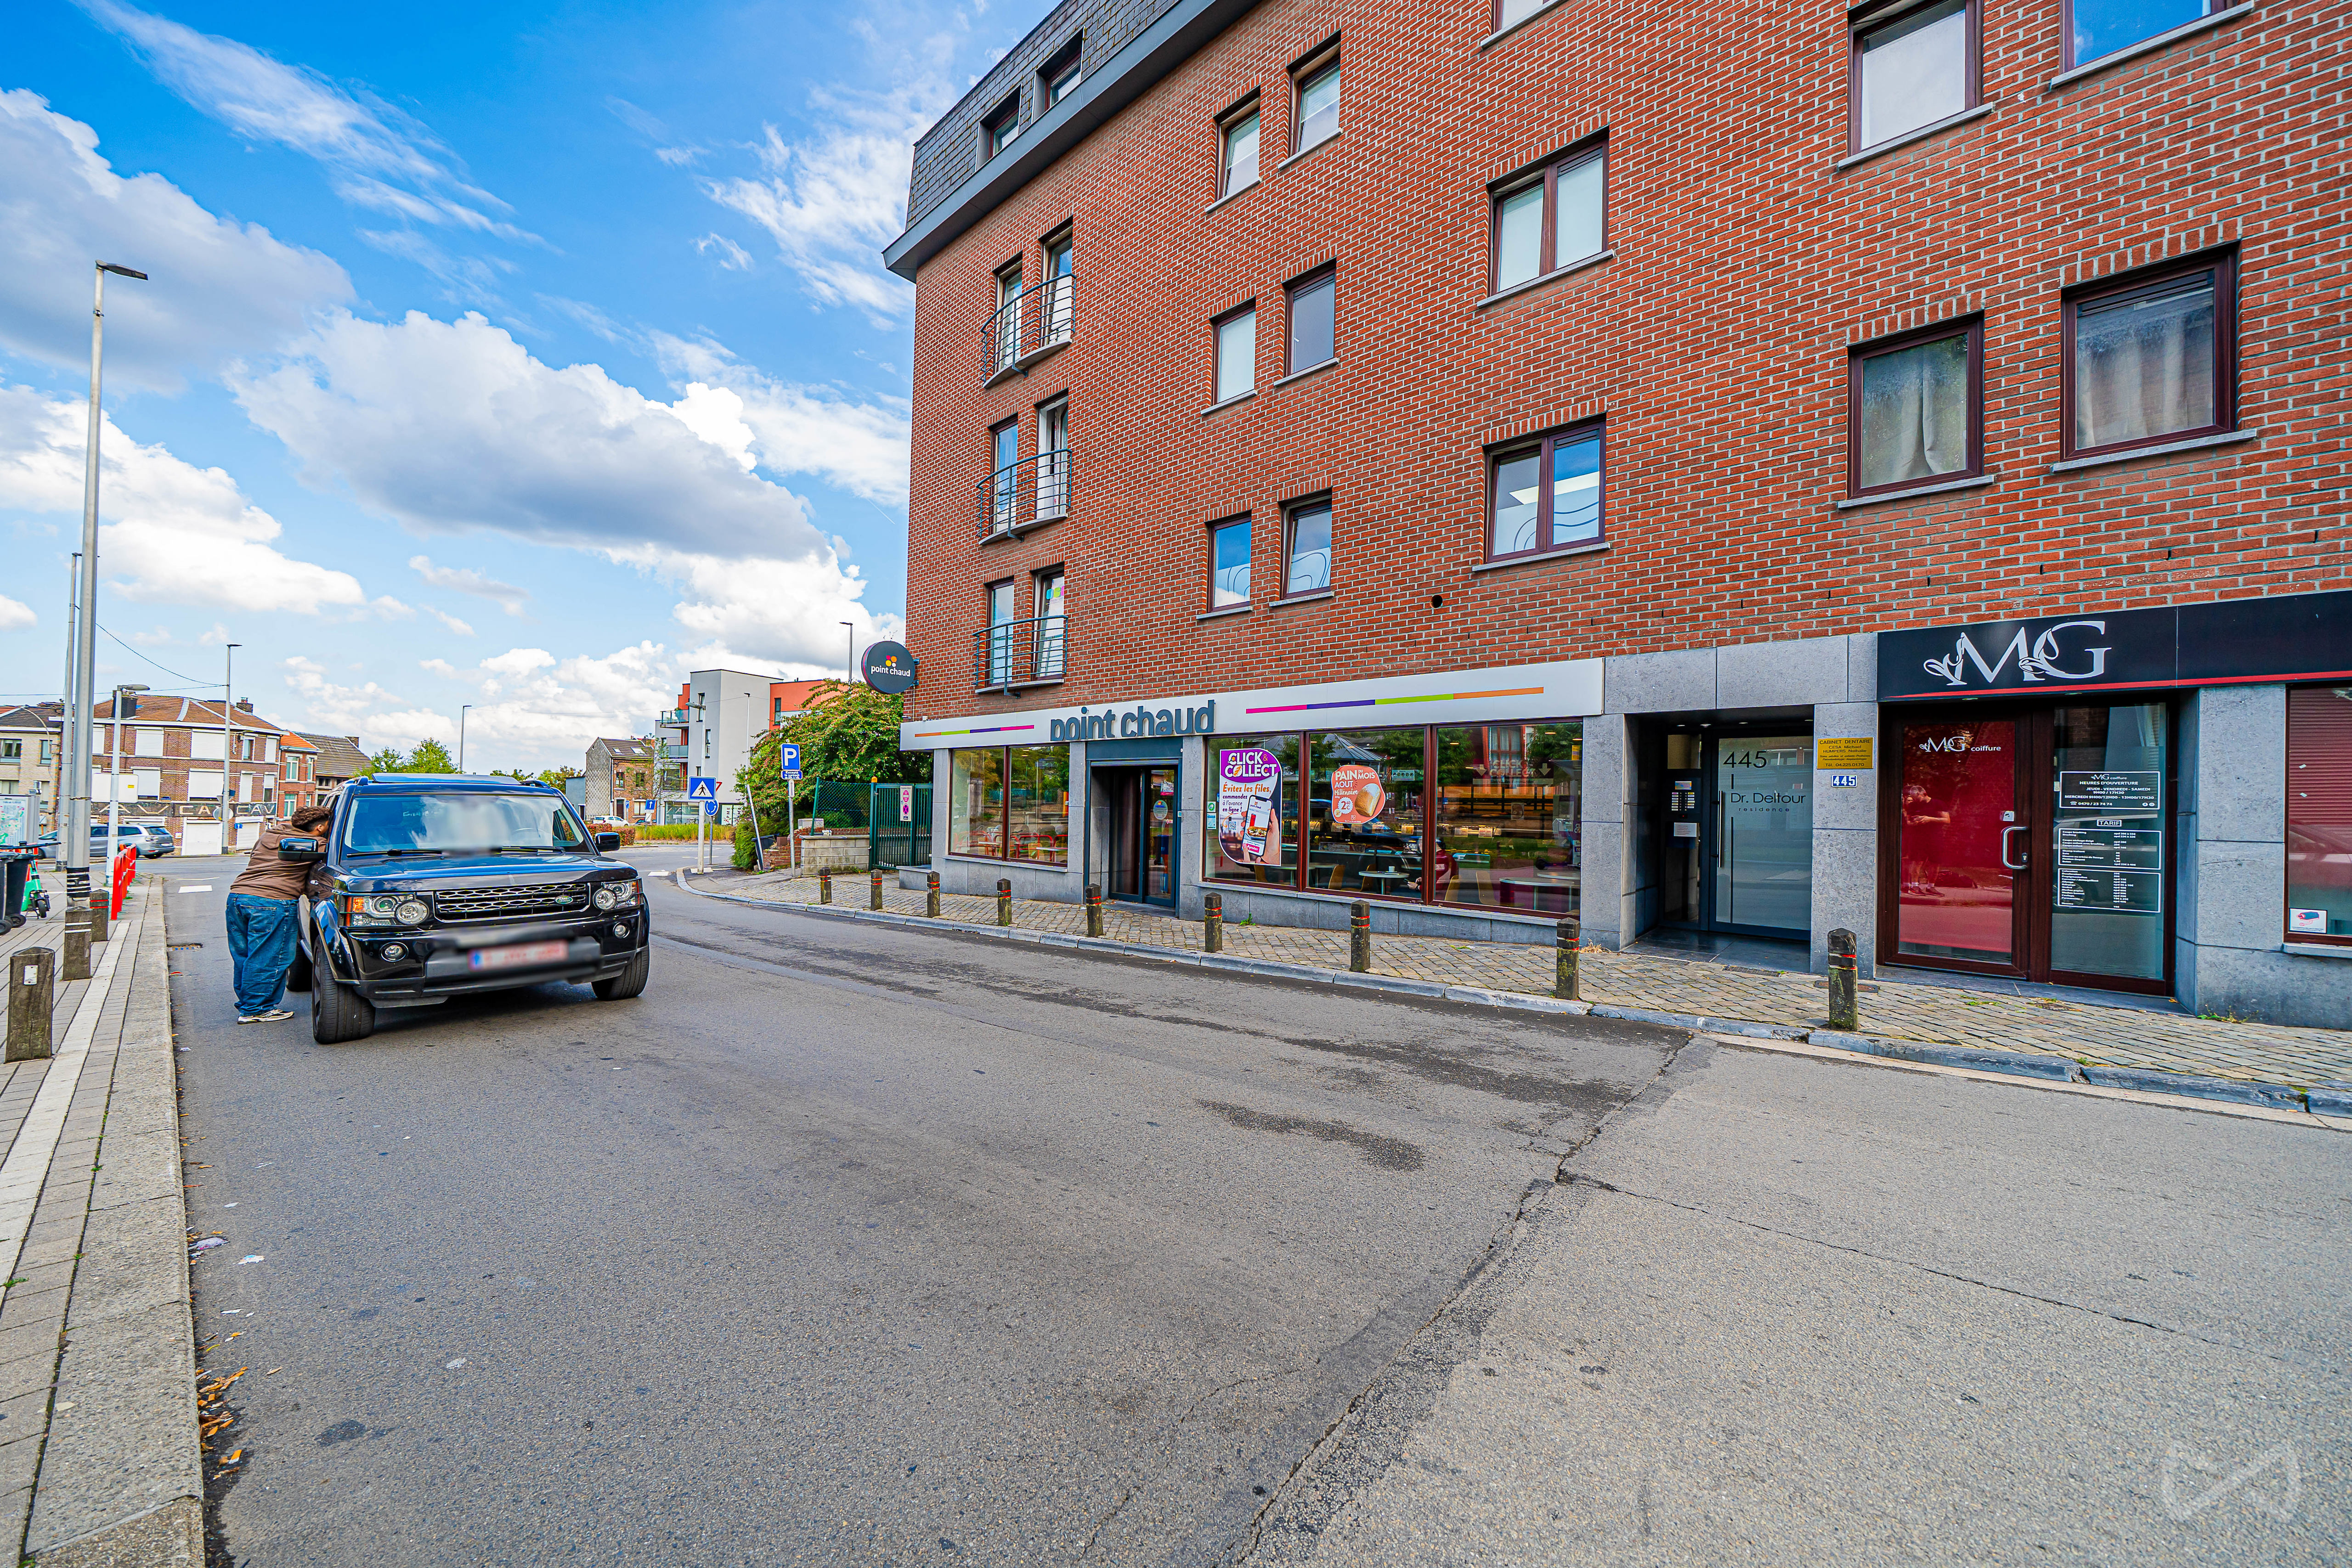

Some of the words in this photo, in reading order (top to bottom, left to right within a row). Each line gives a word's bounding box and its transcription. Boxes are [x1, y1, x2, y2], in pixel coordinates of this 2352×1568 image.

[1924, 621, 2112, 685] MG
[871, 665, 888, 674] point
[889, 667, 910, 677] chaud
[1050, 706, 1116, 741] point
[1121, 699, 1216, 737] chaud
[1919, 736, 1965, 752] MG
[784, 748, 797, 766] P
[1227, 751, 1263, 765] CLICK
[1723, 751, 1767, 768] 445
[1225, 764, 1277, 777] COLLECT
[1335, 770, 1357, 780] PAIN
[1833, 776, 1855, 786] 445
[1223, 782, 1242, 792] Évitez
[1244, 784, 1253, 792] les
[1255, 784, 1271, 795] files,
[1730, 793, 1748, 803] Dr.
[1753, 792, 1806, 804] Deltour
[236, 805, 275, 815] CAV
[1341, 801, 1346, 809] 2
